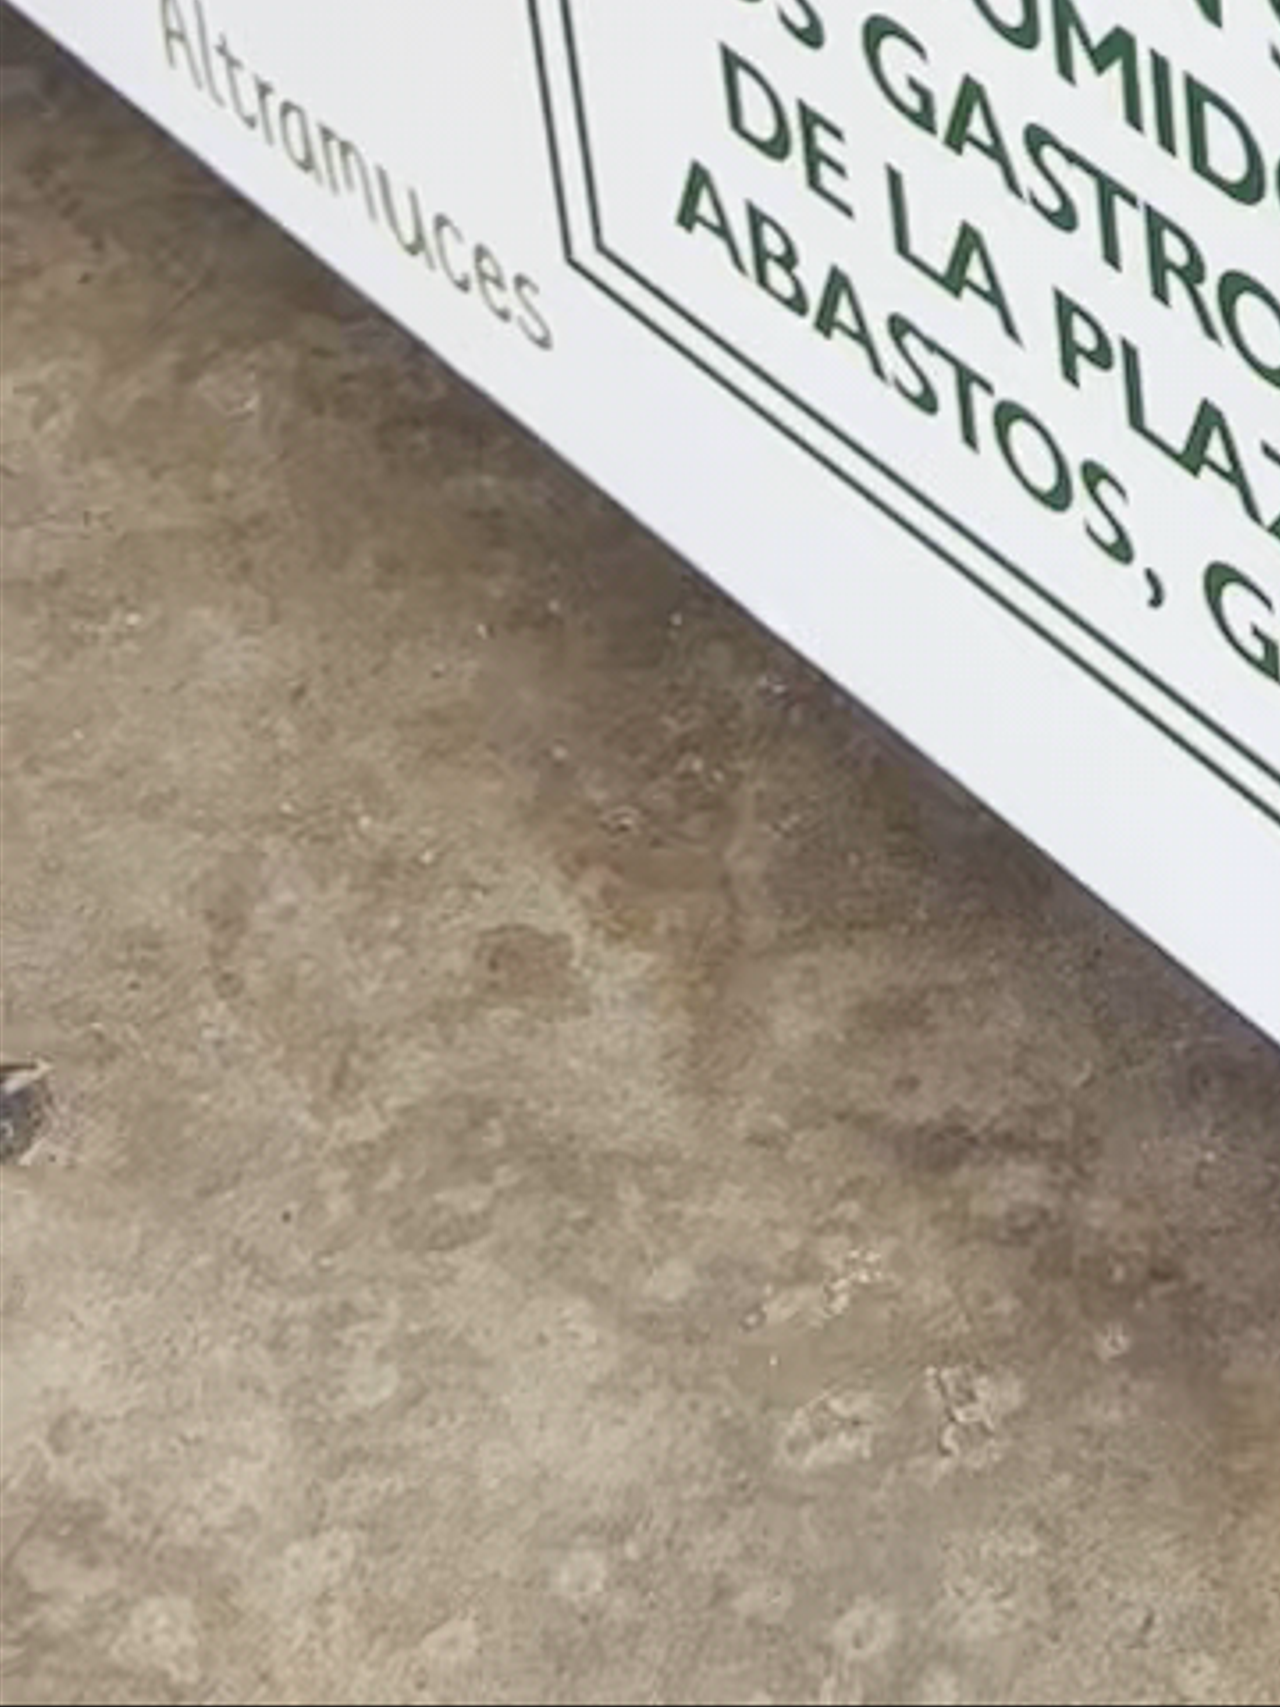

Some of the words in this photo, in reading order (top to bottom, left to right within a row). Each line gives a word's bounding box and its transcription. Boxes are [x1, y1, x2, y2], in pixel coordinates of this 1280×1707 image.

[718, 41, 854, 220] DE
[884, 163, 1023, 347] LA
[675, 159, 1166, 610] ABASTOS,
